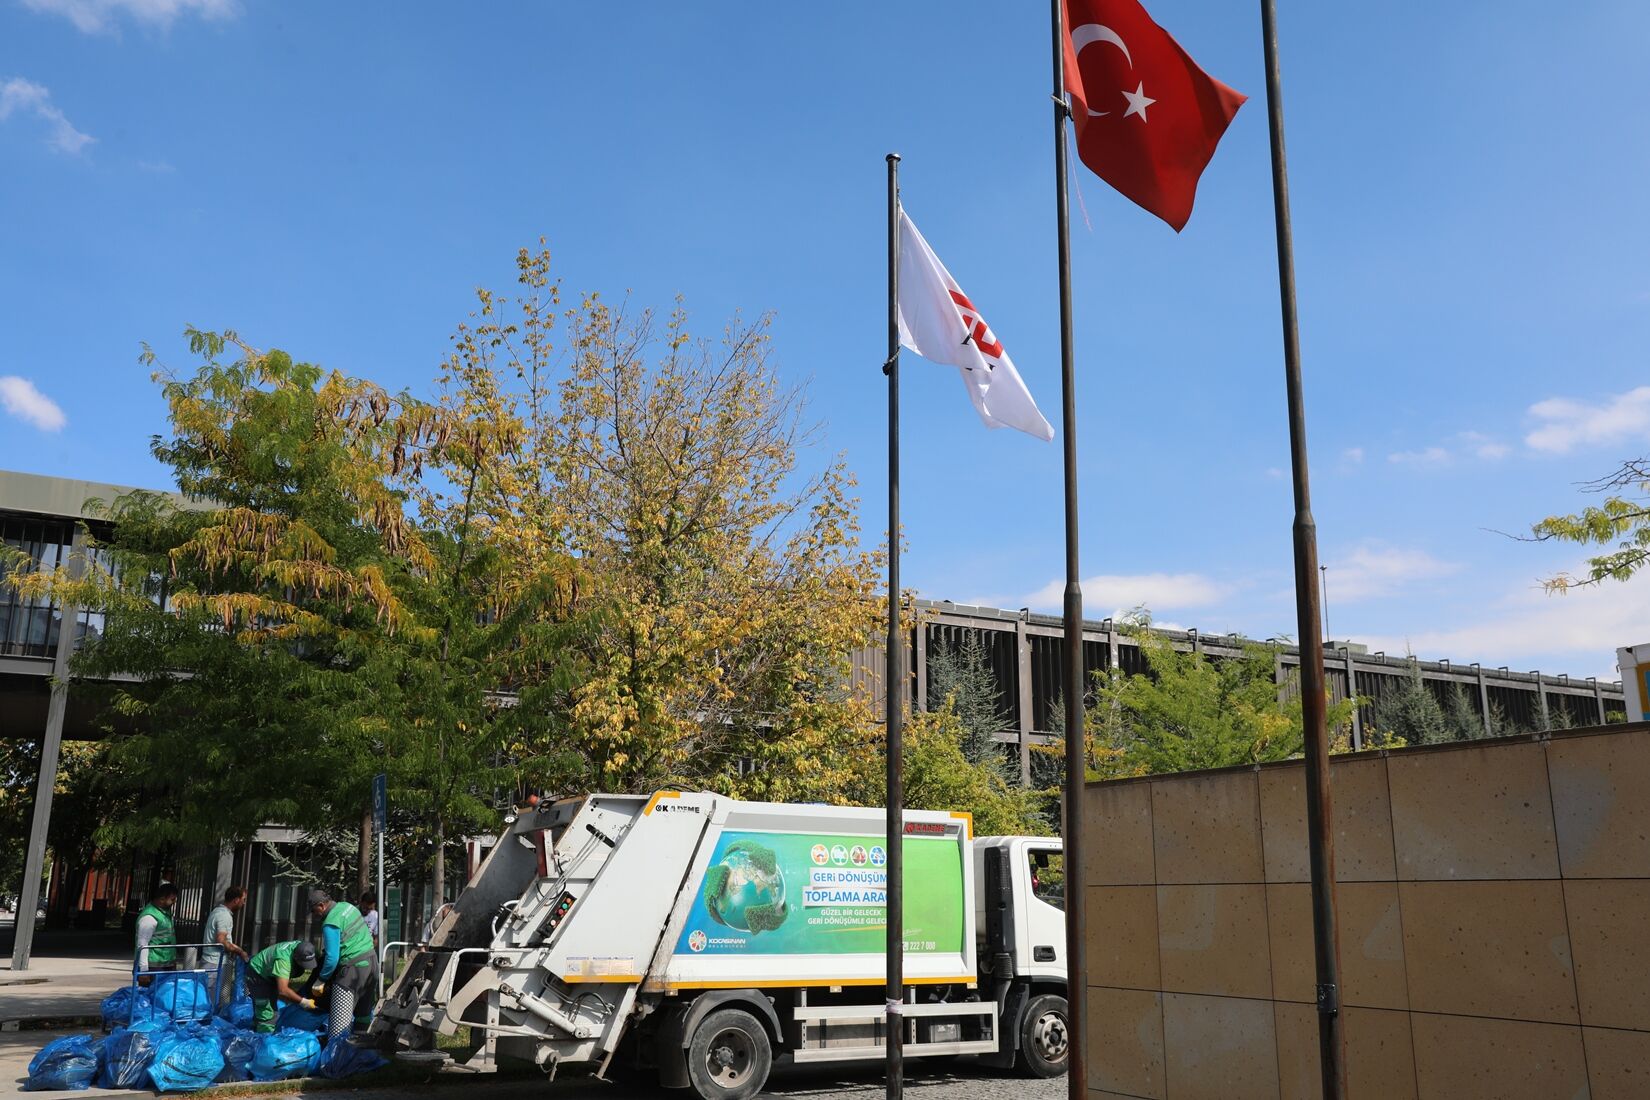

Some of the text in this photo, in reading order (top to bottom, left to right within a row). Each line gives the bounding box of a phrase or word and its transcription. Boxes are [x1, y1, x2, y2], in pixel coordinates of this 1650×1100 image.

[838, 871, 887, 885] DÖNÜŞÜM
[805, 891, 886, 902] TOPLAMA ARA
[821, 907, 842, 916] GÜZEL
[824, 917, 865, 926] DÖNÜŞÜMLE
[910, 941, 920, 950] 222
